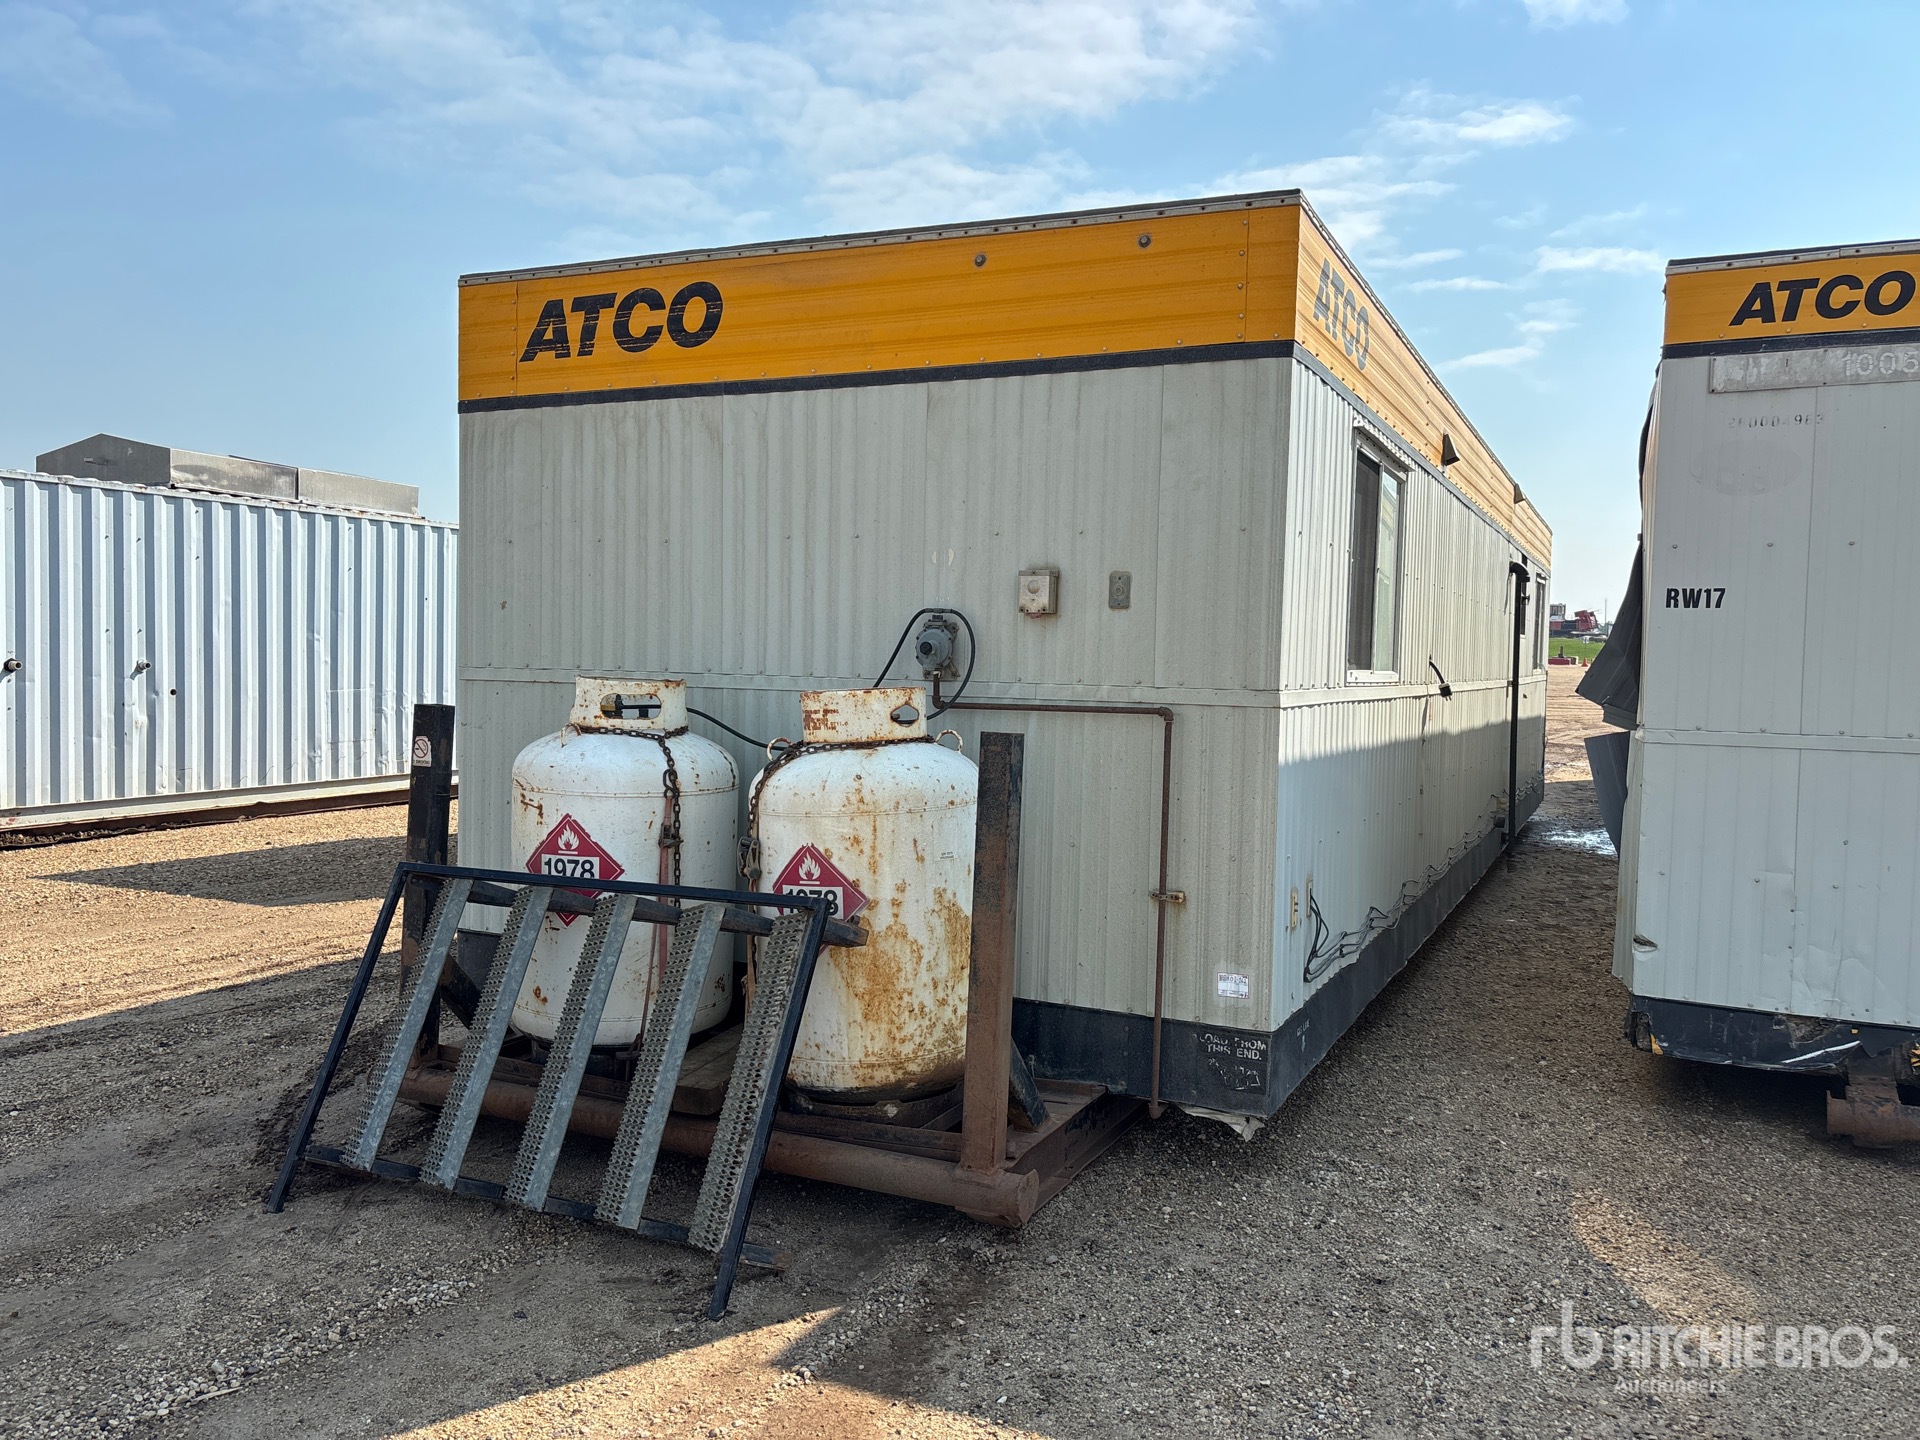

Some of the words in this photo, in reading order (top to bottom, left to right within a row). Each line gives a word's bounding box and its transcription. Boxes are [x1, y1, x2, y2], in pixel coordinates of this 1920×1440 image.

[519, 281, 724, 362] ATCO
[1312, 257, 1370, 371] ATCO
[1728, 270, 1917, 327] ATCO
[1665, 587, 1726, 609] RW17
[544, 857, 595, 879] 1978
